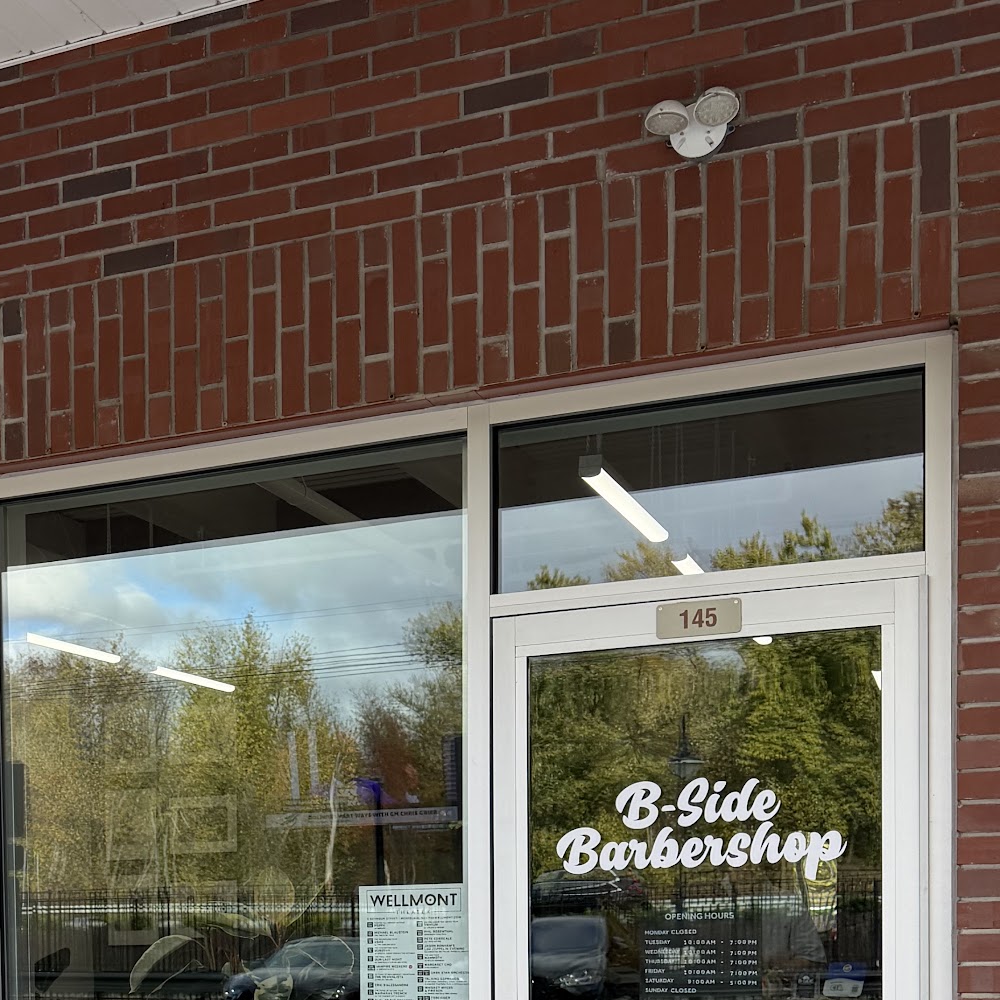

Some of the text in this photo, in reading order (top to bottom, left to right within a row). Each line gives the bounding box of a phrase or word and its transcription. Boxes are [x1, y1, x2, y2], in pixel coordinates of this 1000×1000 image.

[679, 607, 718, 629] 145
[615, 777, 781, 829] B-Side
[556, 821, 848, 880] Barbershop
[370, 893, 458, 907] WELLMONT
[665, 912, 703, 920] OPENING
